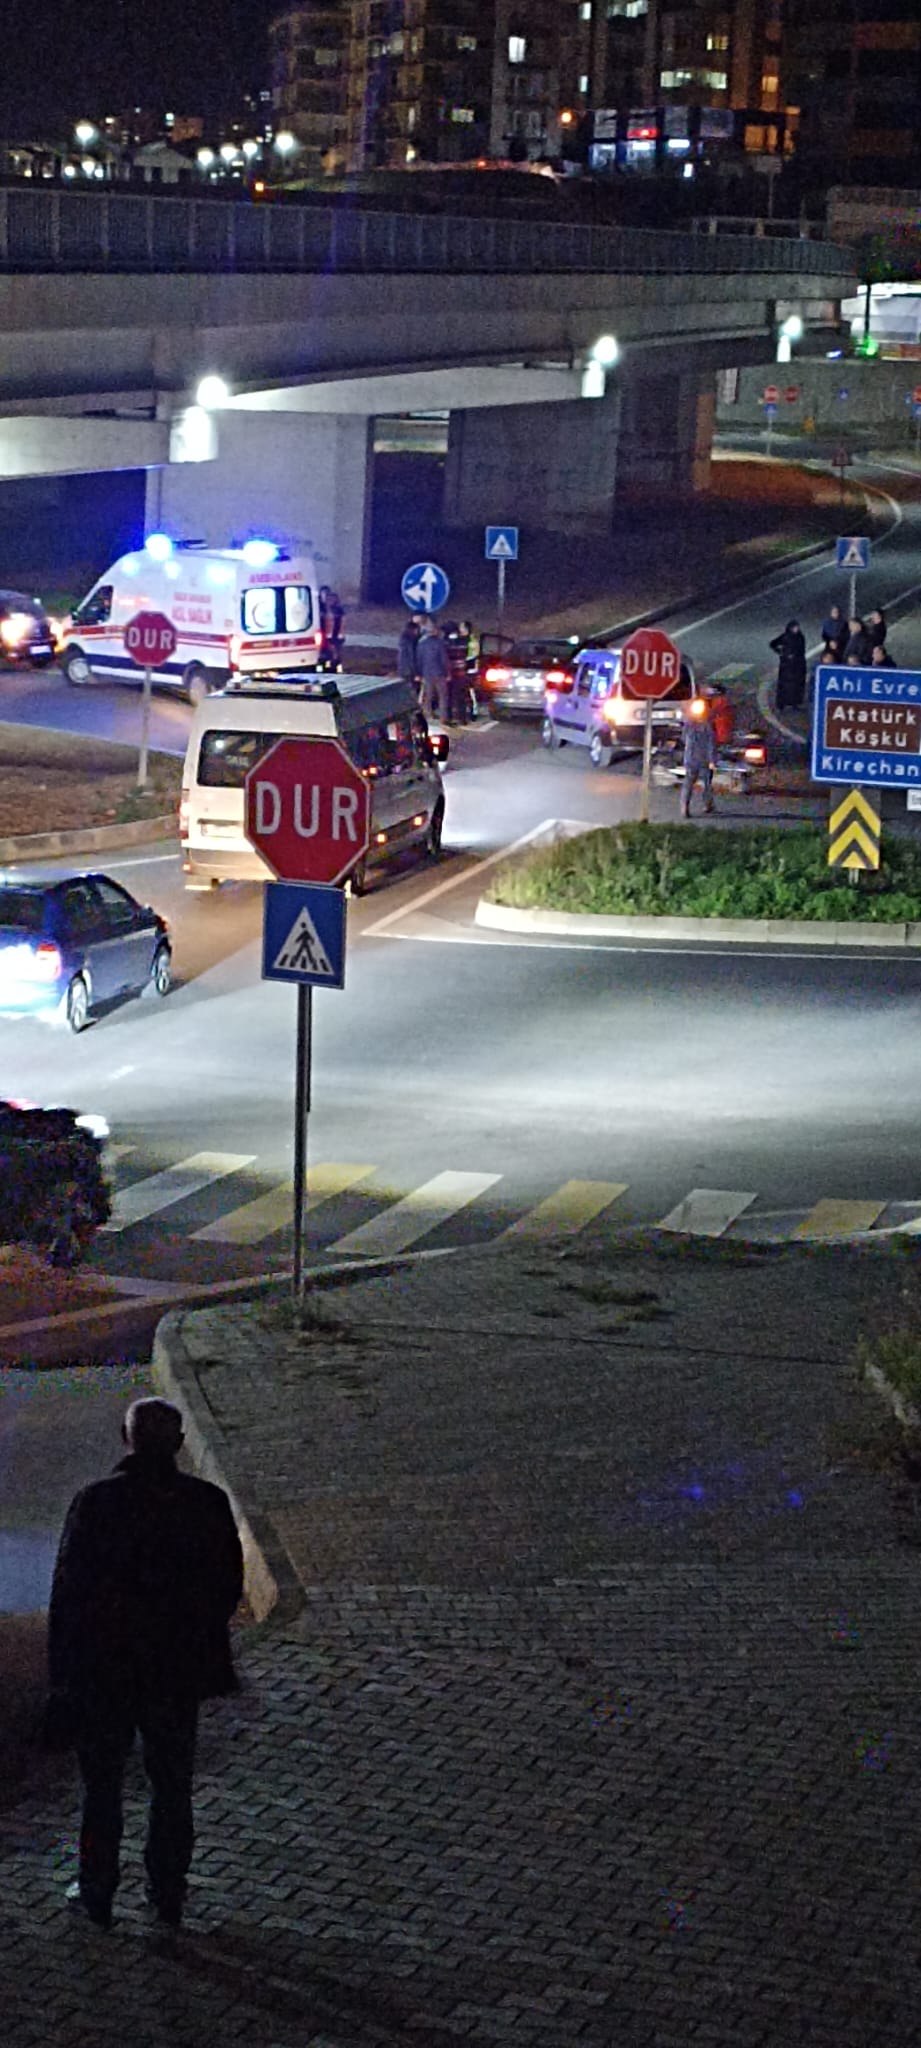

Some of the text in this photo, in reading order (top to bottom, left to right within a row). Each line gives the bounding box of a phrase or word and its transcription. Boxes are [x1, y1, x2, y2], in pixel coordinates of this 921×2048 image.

[128, 627, 173, 650] DUR
[625, 650, 676, 678] DUR
[826, 676, 862, 693] Ahi
[832, 705, 917, 725] Atatürk
[840, 728, 908, 747] Köşkü
[256, 780, 359, 842] DUR
